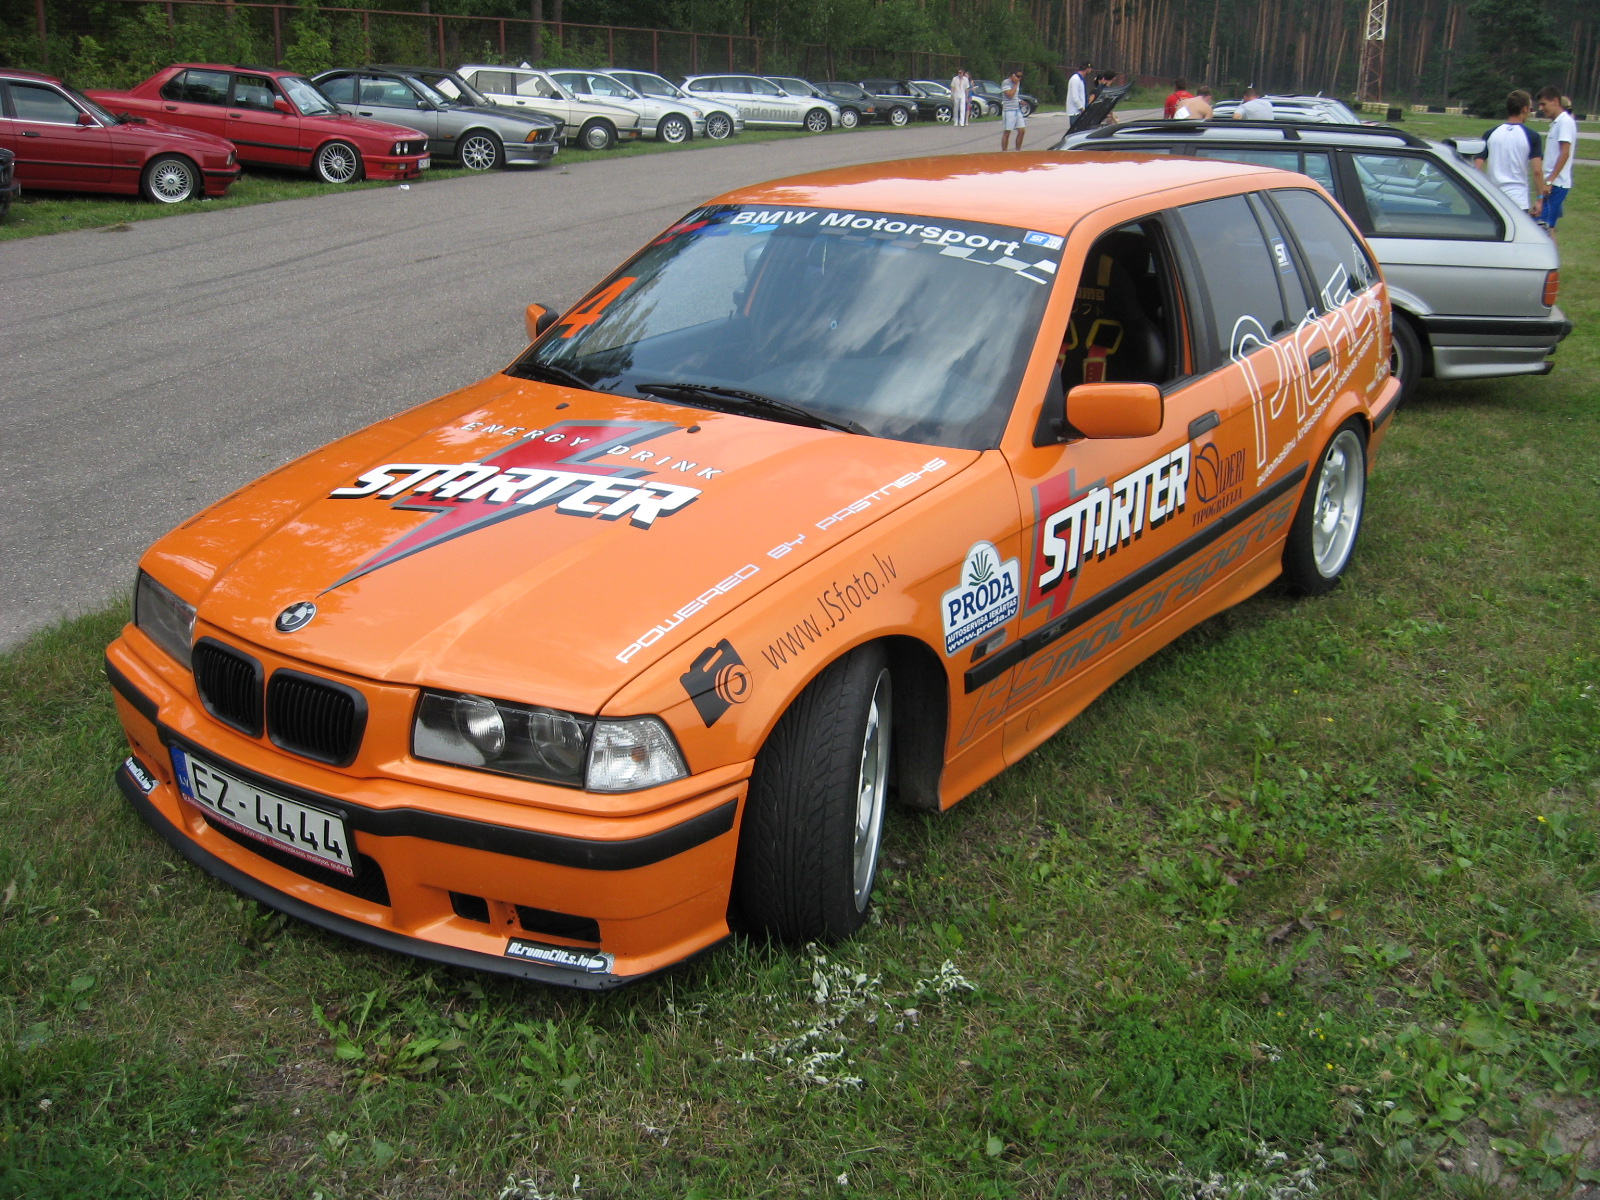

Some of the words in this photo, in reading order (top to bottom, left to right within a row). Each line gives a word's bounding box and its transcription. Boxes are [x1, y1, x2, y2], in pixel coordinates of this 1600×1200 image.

[730, 211, 819, 226] BMW
[819, 212, 1021, 257] Motorsport
[460, 421, 591, 446] ENERGY
[606, 445, 726, 481] DRINK
[328, 462, 703, 530] STARTER
[1039, 442, 1190, 594] STARTER
[616, 563, 760, 664] POWERED
[767, 533, 806, 559] BY
[761, 553, 897, 670] www.JSfoto.lv
[947, 614, 989, 645] AUTOSERVISA
[948, 571, 1015, 627] PRODA
[948, 607, 1016, 652] www.proda.lv
[191, 761, 344, 860] EZ-4444
